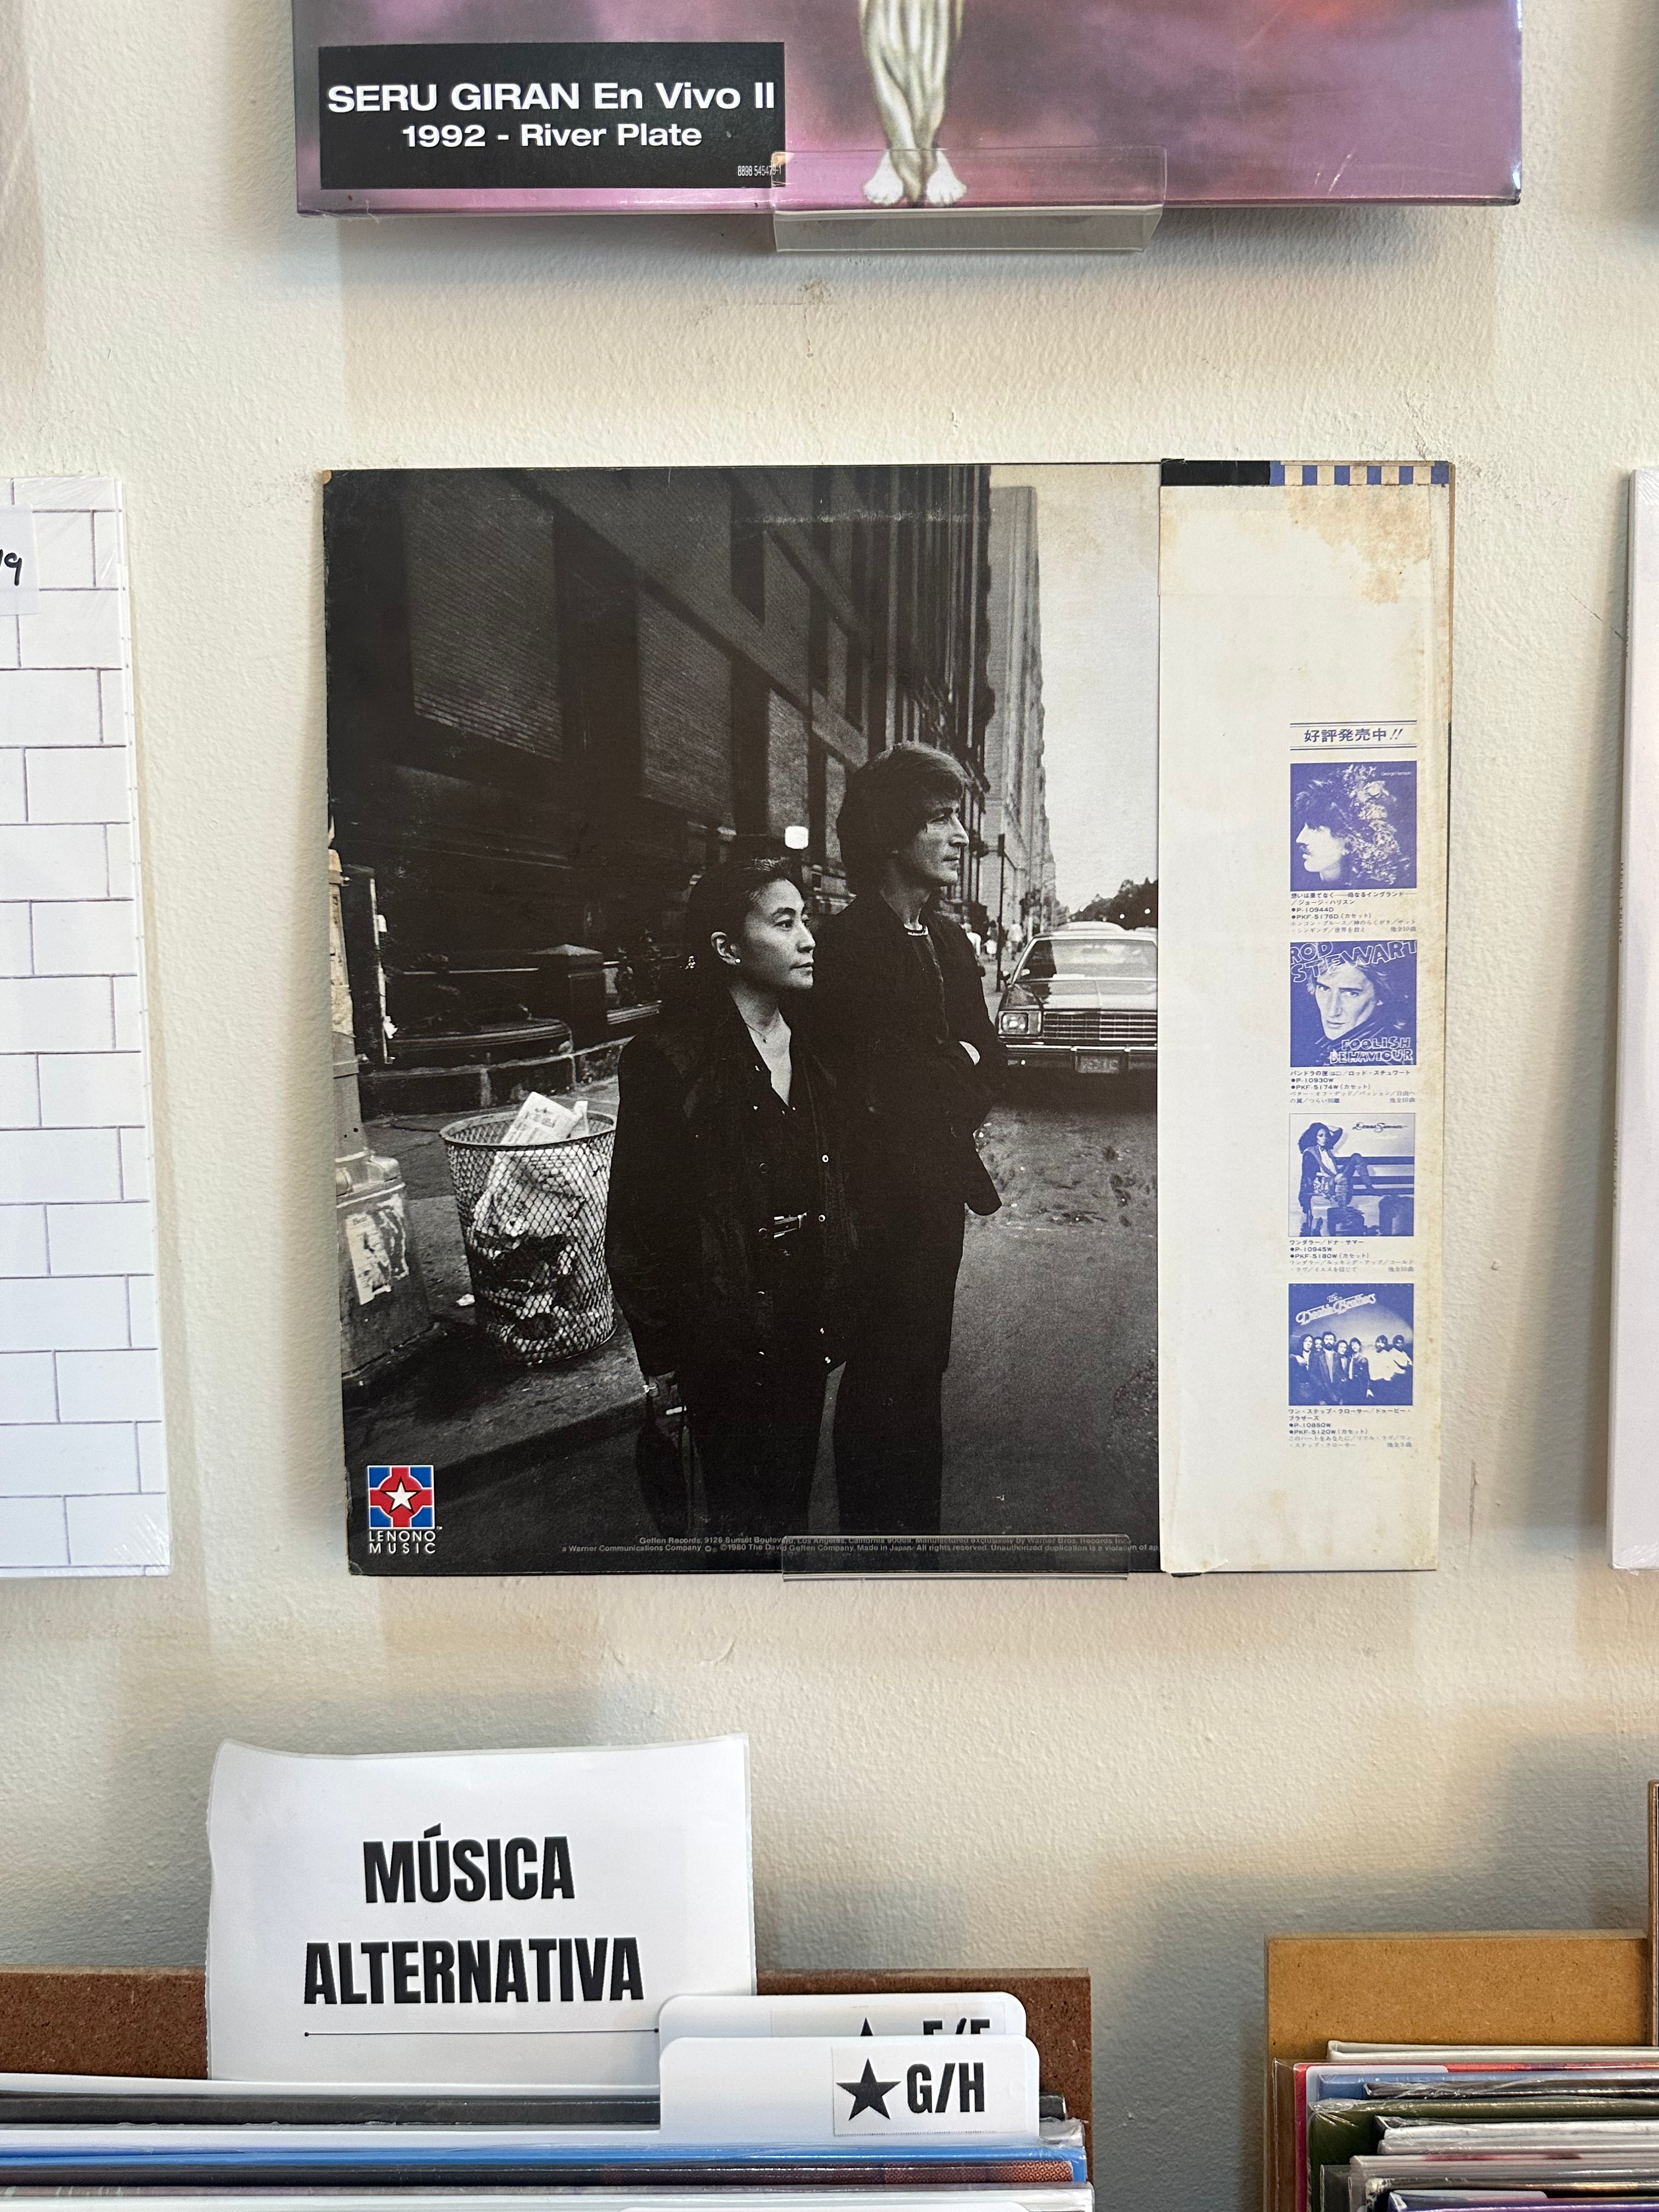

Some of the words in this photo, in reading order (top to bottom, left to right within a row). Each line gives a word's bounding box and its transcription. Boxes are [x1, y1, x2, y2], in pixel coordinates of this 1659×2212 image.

[328, 84, 437, 113] SERU
[450, 81, 579, 111] GIRAN
[594, 82, 643, 110] En
[654, 81, 741, 110] Vivo
[754, 82, 775, 109] II
[402, 124, 486, 148] 1992
[520, 123, 607, 148] River
[618, 122, 703, 146] Plate
[737, 165, 753, 176] 8898
[1304, 728, 1403, 743] 好評発売中!!
[1290, 941, 1333, 964] ROD
[1290, 940, 1417, 983] STEWART
[1341, 1036, 1411, 1051] FOOLISH
[1329, 1048, 1413, 1064] BEHAVIOUR
[369, 1530, 436, 1542] LENONO
[369, 1543, 436, 1554] MUSIC
[363, 1823, 575, 1904] MÚSICA
[303, 1936, 645, 2005] ALTERNATIVA
[907, 2062, 985, 2113] G/H
